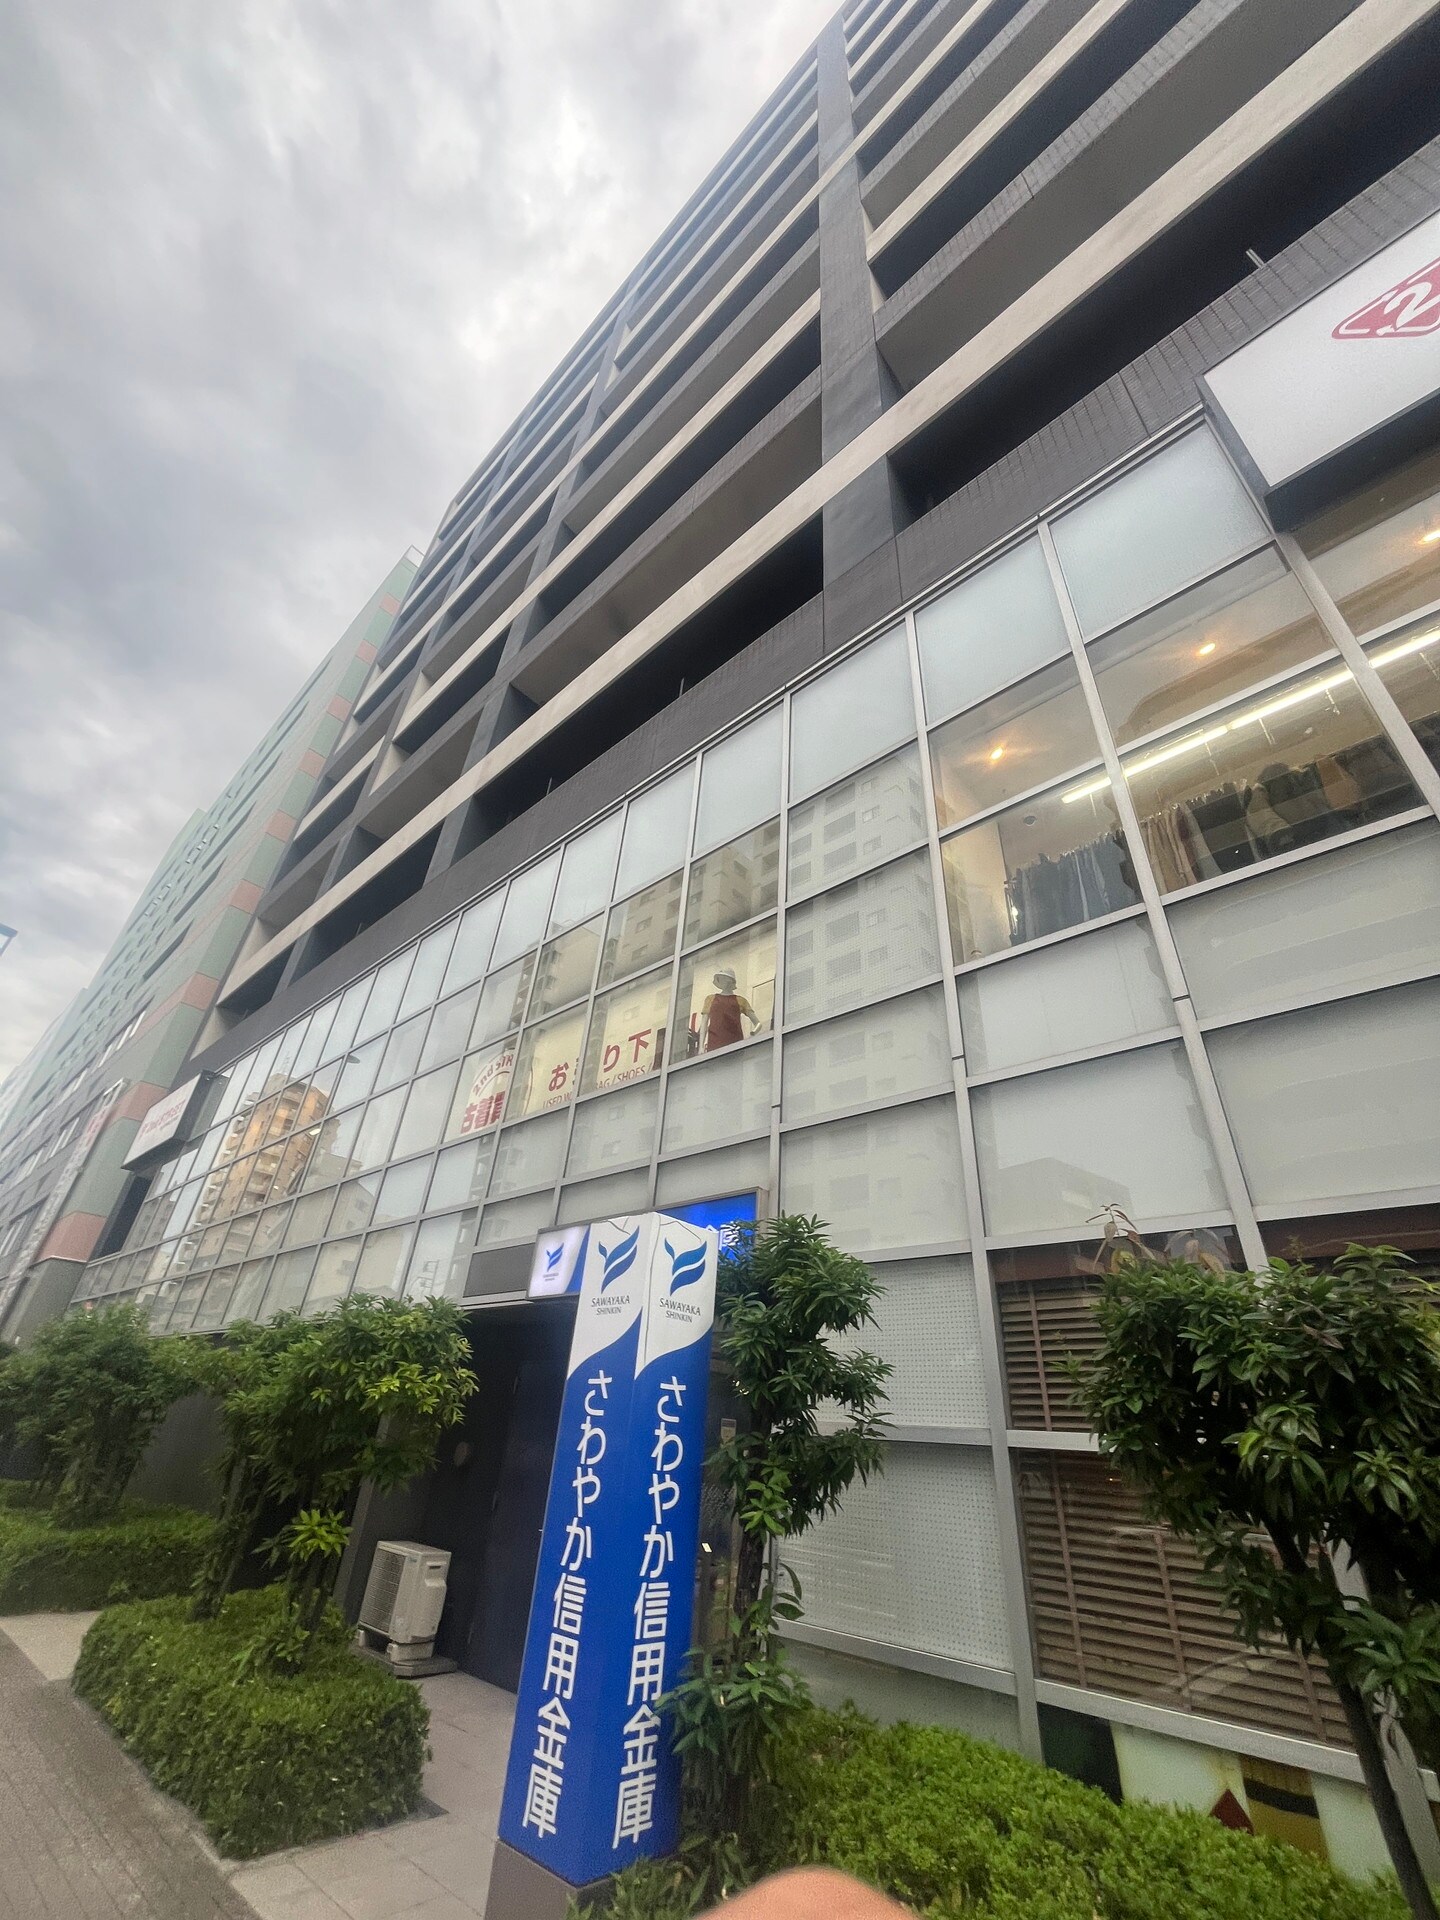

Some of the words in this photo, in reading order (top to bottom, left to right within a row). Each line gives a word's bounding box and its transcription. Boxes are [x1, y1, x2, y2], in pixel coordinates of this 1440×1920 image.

[617, 1064, 646, 1081] SHOES
[591, 1295, 630, 1308] SAWAYAKA
[659, 1297, 701, 1317] SAWAYAKA
[596, 1306, 622, 1316] SHINKIN
[665, 1310, 693, 1323] SHINKIN
[522, 1369, 612, 1839] さわやか信用金庫
[612, 1375, 687, 1850] さわやか信用金庫
